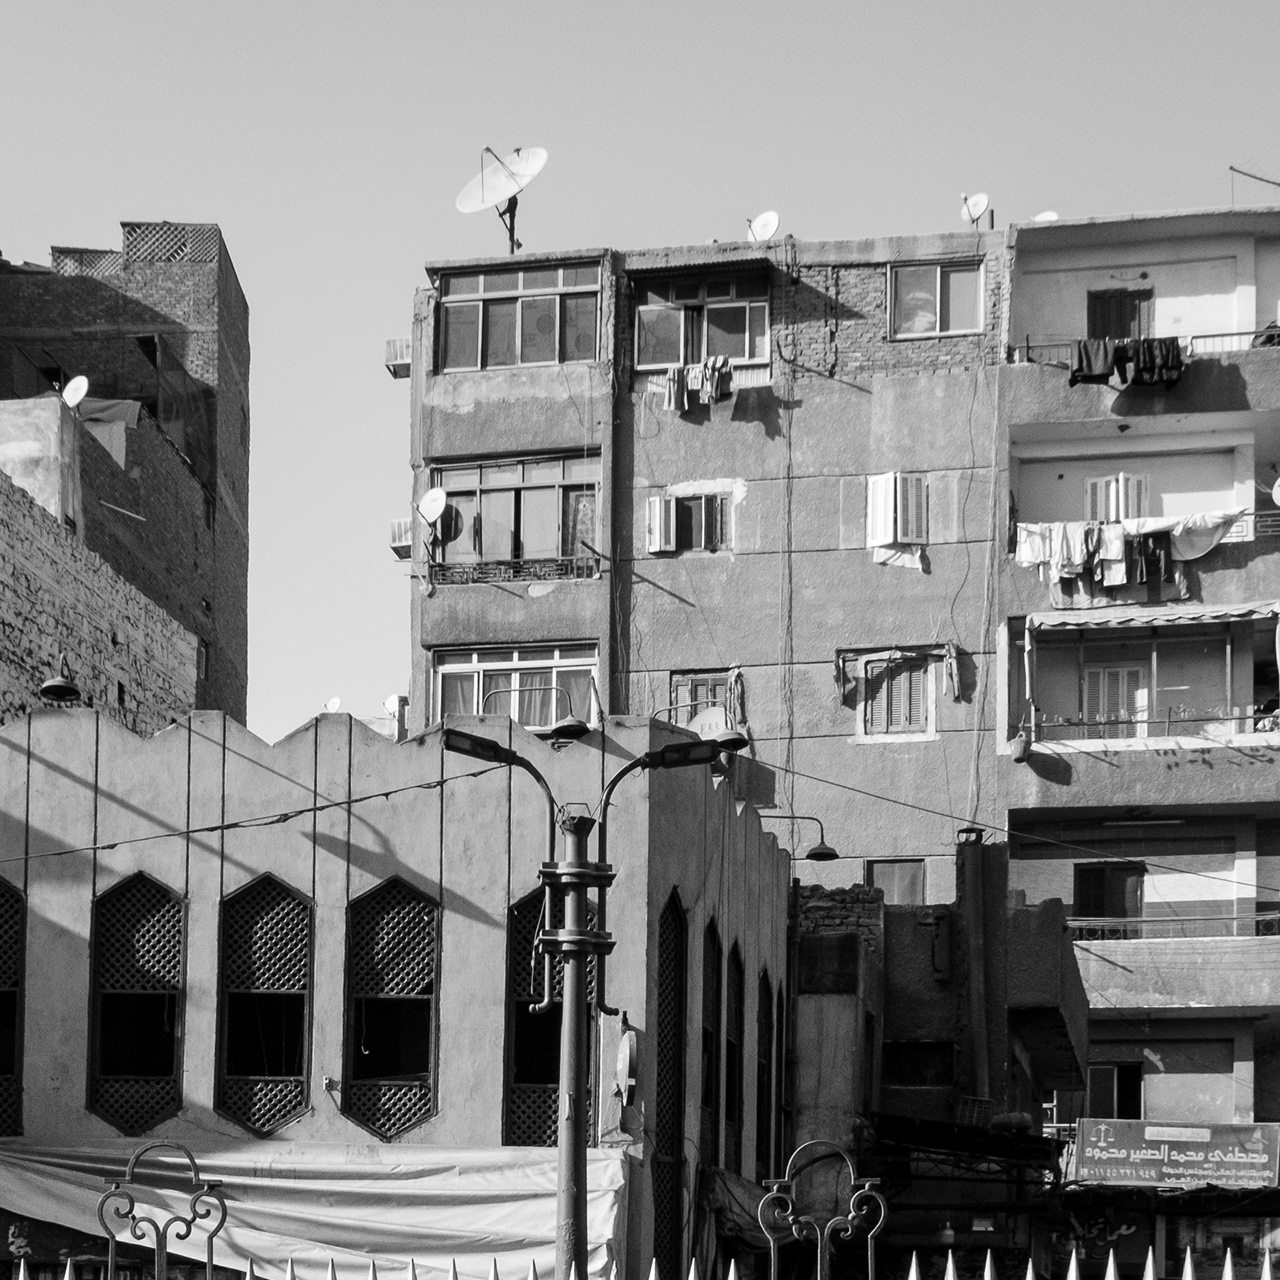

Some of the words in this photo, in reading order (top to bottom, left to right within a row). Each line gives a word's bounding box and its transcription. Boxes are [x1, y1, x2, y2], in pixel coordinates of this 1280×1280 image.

[1084, 1146, 1128, 1162] محمود
[1128, 1143, 1169, 1164] الصغير
[1169, 1147, 1205, 1163] محمد
